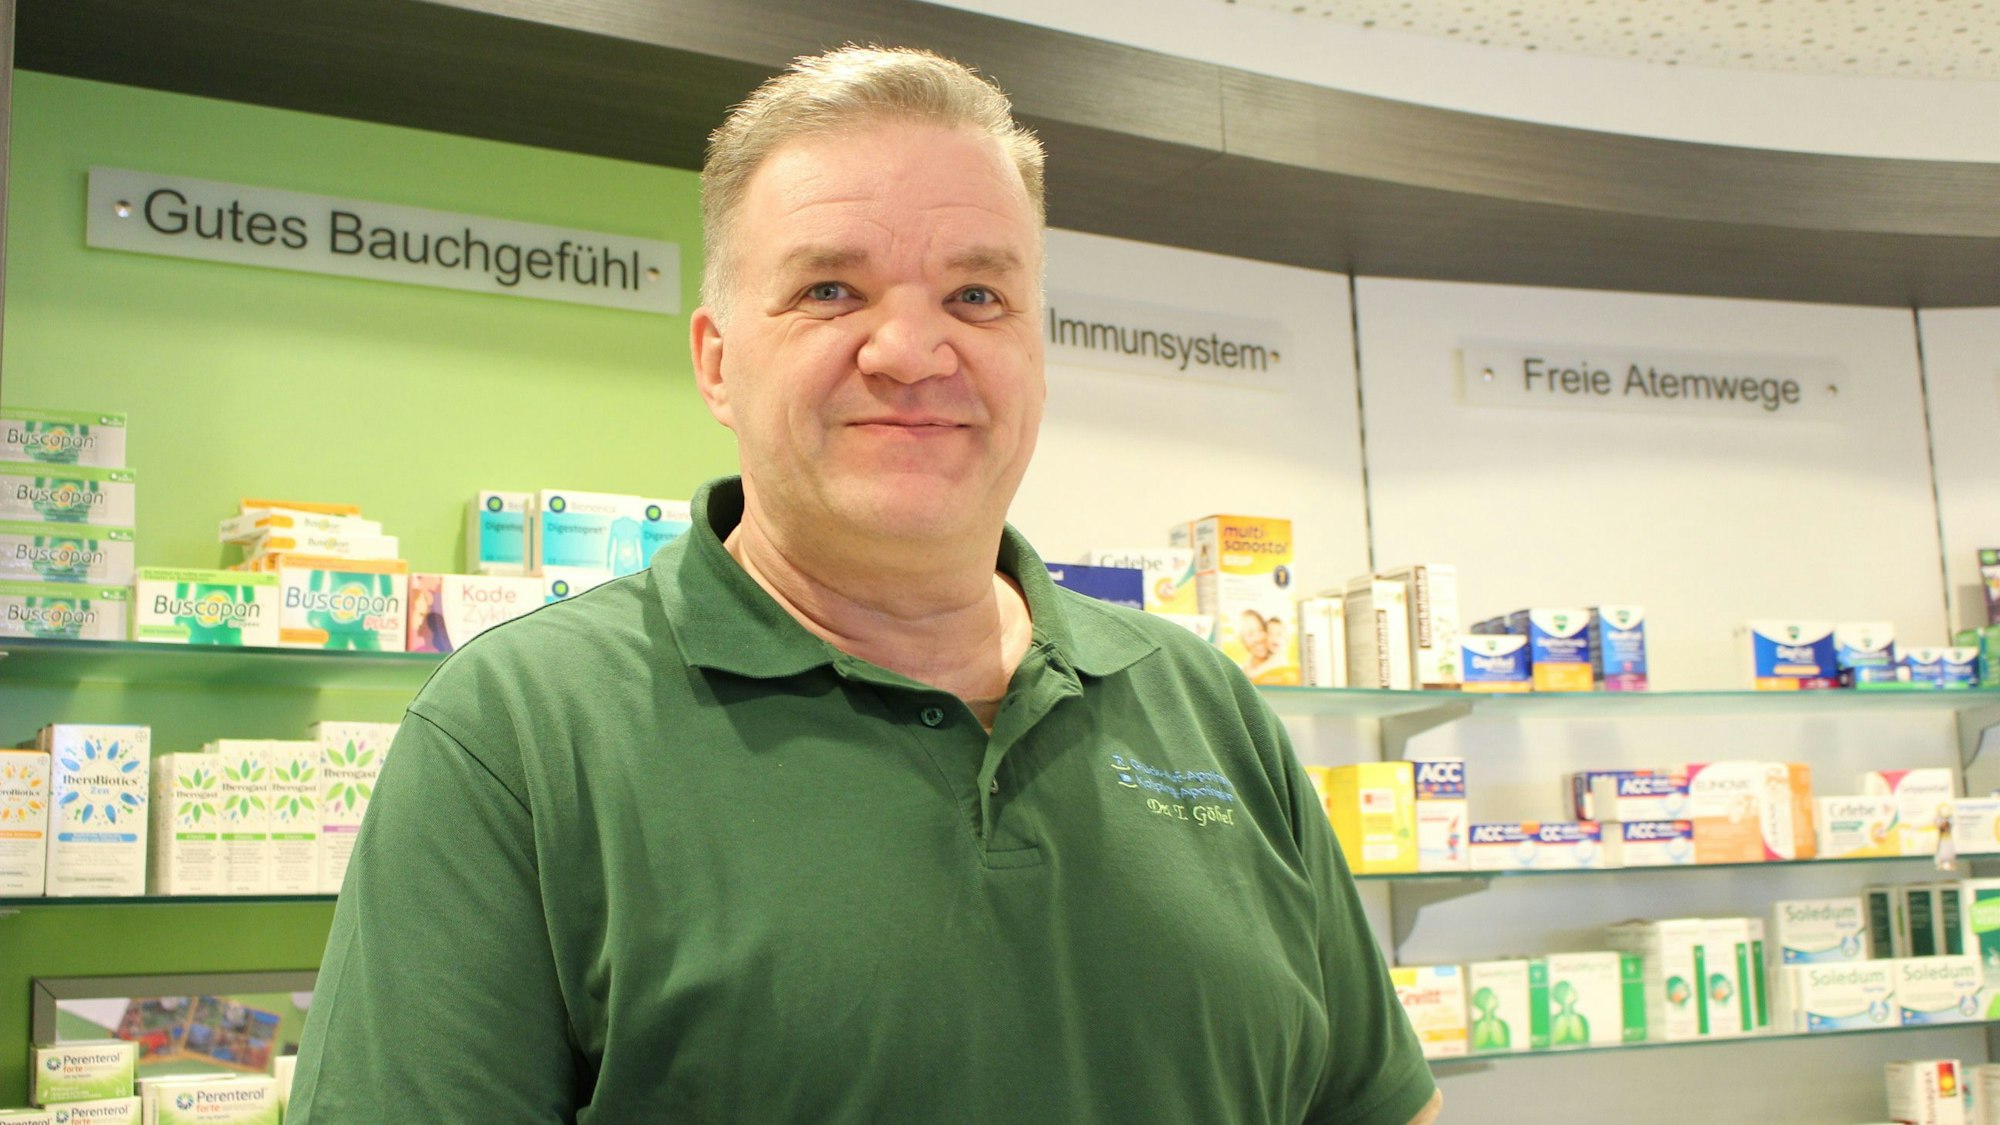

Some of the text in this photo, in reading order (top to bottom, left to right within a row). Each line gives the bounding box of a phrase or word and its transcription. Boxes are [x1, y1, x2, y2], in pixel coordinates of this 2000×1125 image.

[143, 188, 639, 290] Gutes Bauchgefühl
[1050, 307, 1268, 371] Immunsystem
[1523, 358, 1800, 411] Freie Atemwege
[7, 428, 96, 451] Buscopan
[16, 484, 104, 506] Buscopan
[15, 543, 103, 566] Buscopan
[285, 586, 399, 618] Buscopan
[462, 584, 517, 604] Kade
[7, 603, 96, 626] Buscopan
[153, 595, 261, 620] Buscopan
[63, 774, 138, 786] IberoBiotics
[1419, 763, 1461, 783] ACC
[1620, 778, 1652, 794] ACC
[1474, 825, 1503, 841] ACC
[1540, 826, 1561, 841] CC
[1627, 822, 1657, 839] ACC
[1784, 905, 1857, 923] Soledum
[1809, 969, 1885, 987] Soledum
[1903, 964, 1975, 982] Soledum
[63, 1053, 120, 1066] Perenterol
[63, 1064, 83, 1073] forte
[196, 1088, 265, 1103] Perenterol
[71, 1105, 128, 1118] Perenterol
[196, 1104, 221, 1113] forte
